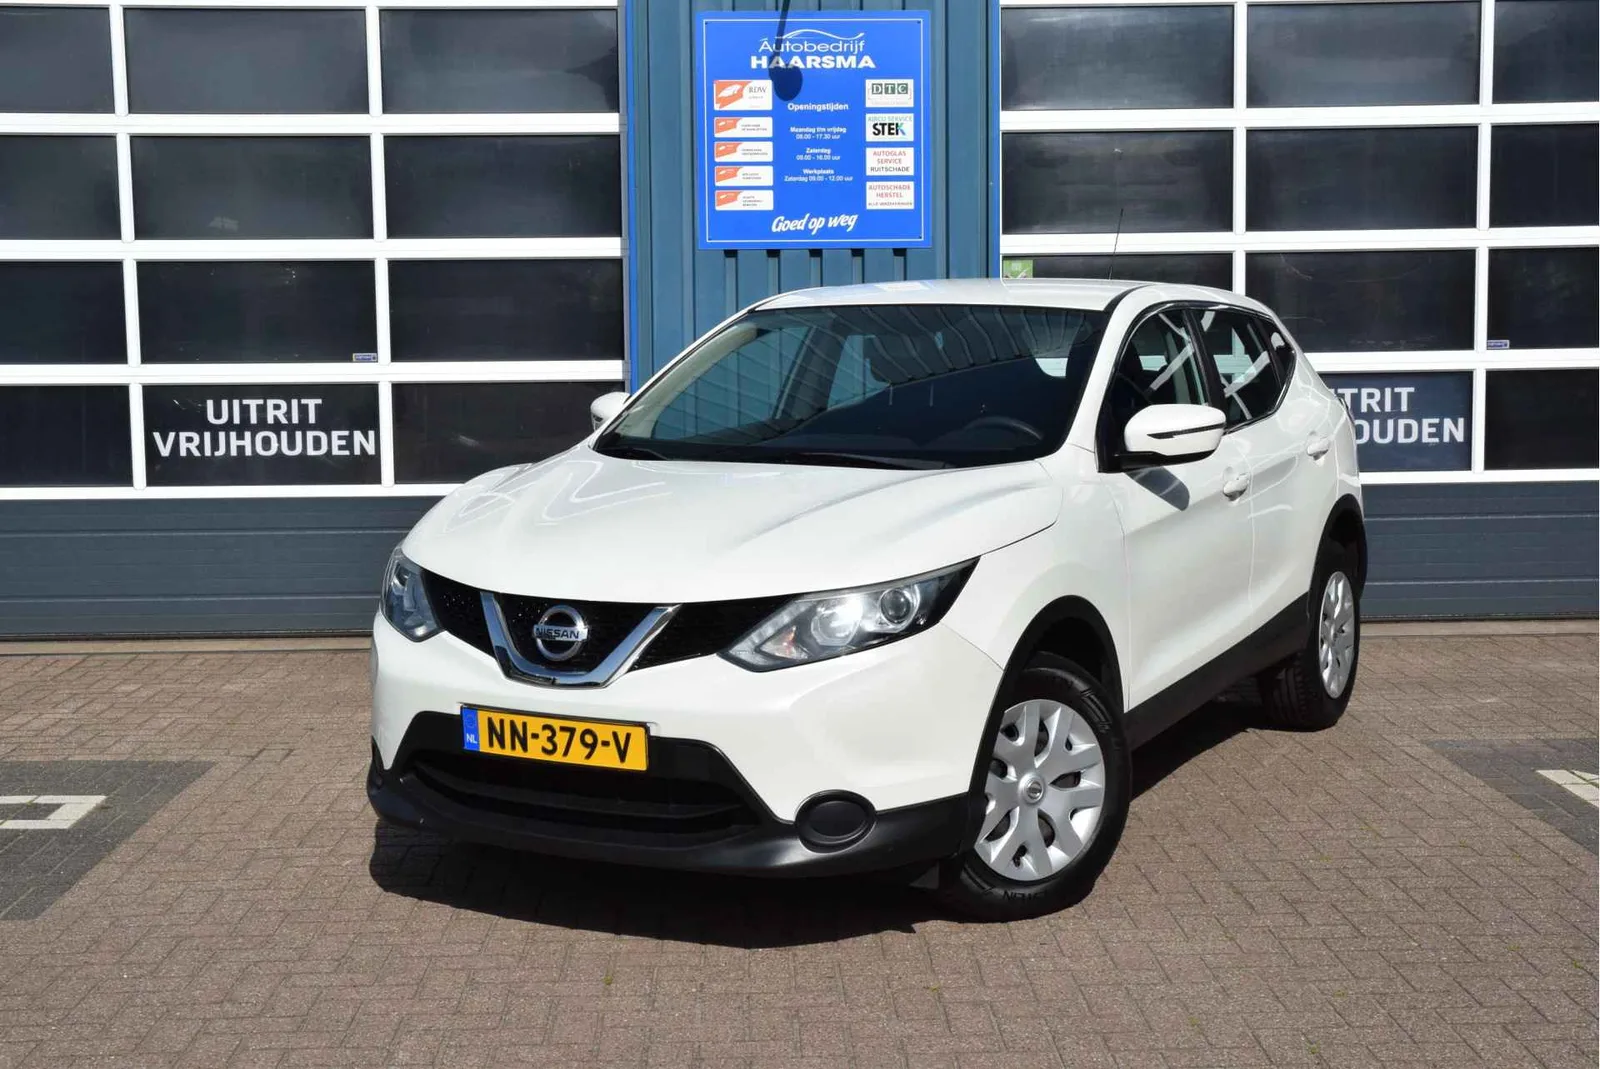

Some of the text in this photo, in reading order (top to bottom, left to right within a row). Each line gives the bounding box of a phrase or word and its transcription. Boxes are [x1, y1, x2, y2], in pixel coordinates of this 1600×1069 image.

[759, 39, 865, 54] Autobedrijf
[751, 55, 876, 69] HAARSMA
[872, 83, 908, 95] DTC
[787, 102, 849, 112] Openingstijden
[827, 126, 847, 134] vrijdag
[872, 122, 906, 136] STEK
[806, 147, 831, 155] Zaterdag
[802, 168, 835, 176] Werkplaats
[868, 184, 911, 192] AUTOSCHADE
[771, 213, 859, 235] Goed op weg
[1330, 387, 1415, 413] TRIT
[206, 399, 322, 424] UITRIT
[1354, 418, 1465, 444] OUDEN
[153, 430, 375, 457] VRIJHOUDEN
[535, 627, 580, 640] NISSAN
[466, 734, 477, 744] NL
[487, 716, 632, 764] NN-379-V
